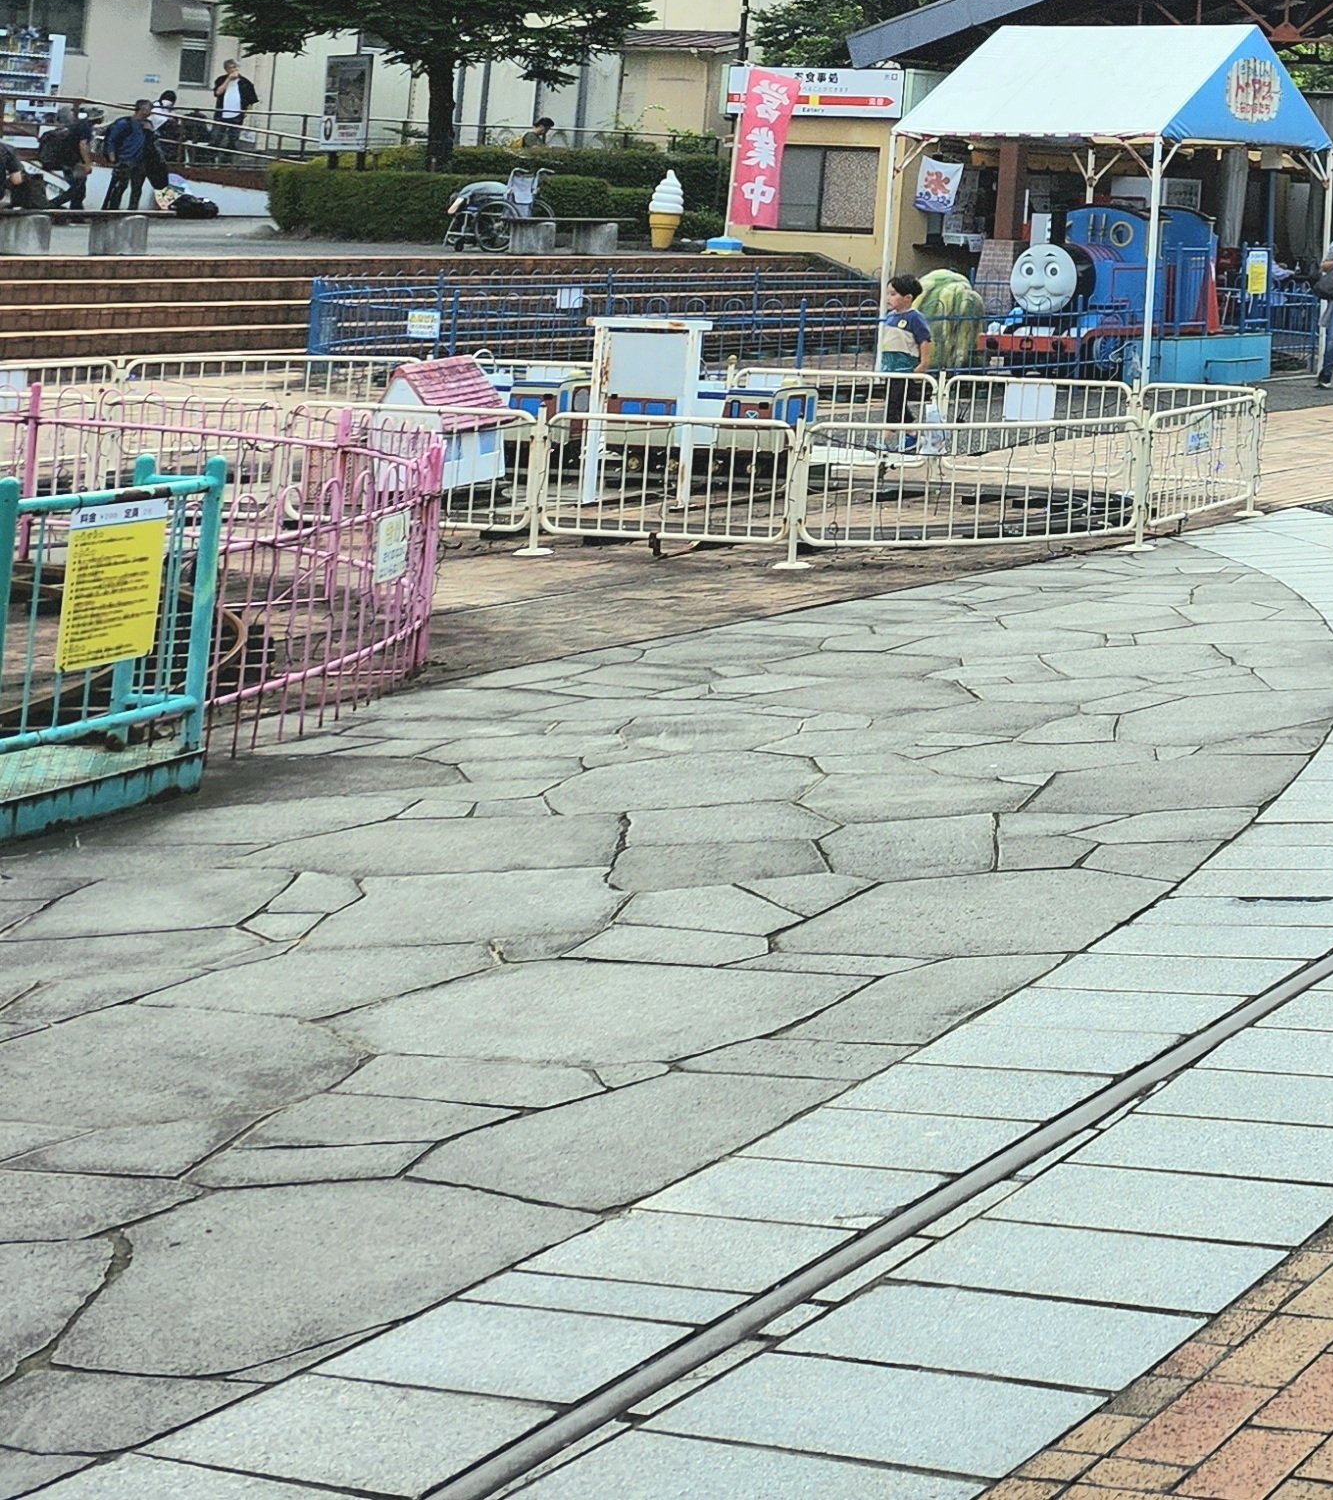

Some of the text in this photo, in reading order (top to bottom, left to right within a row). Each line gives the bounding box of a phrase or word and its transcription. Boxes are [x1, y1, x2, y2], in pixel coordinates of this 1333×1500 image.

[741, 79, 790, 217] 営業中
[923, 170, 951, 197] 氷
